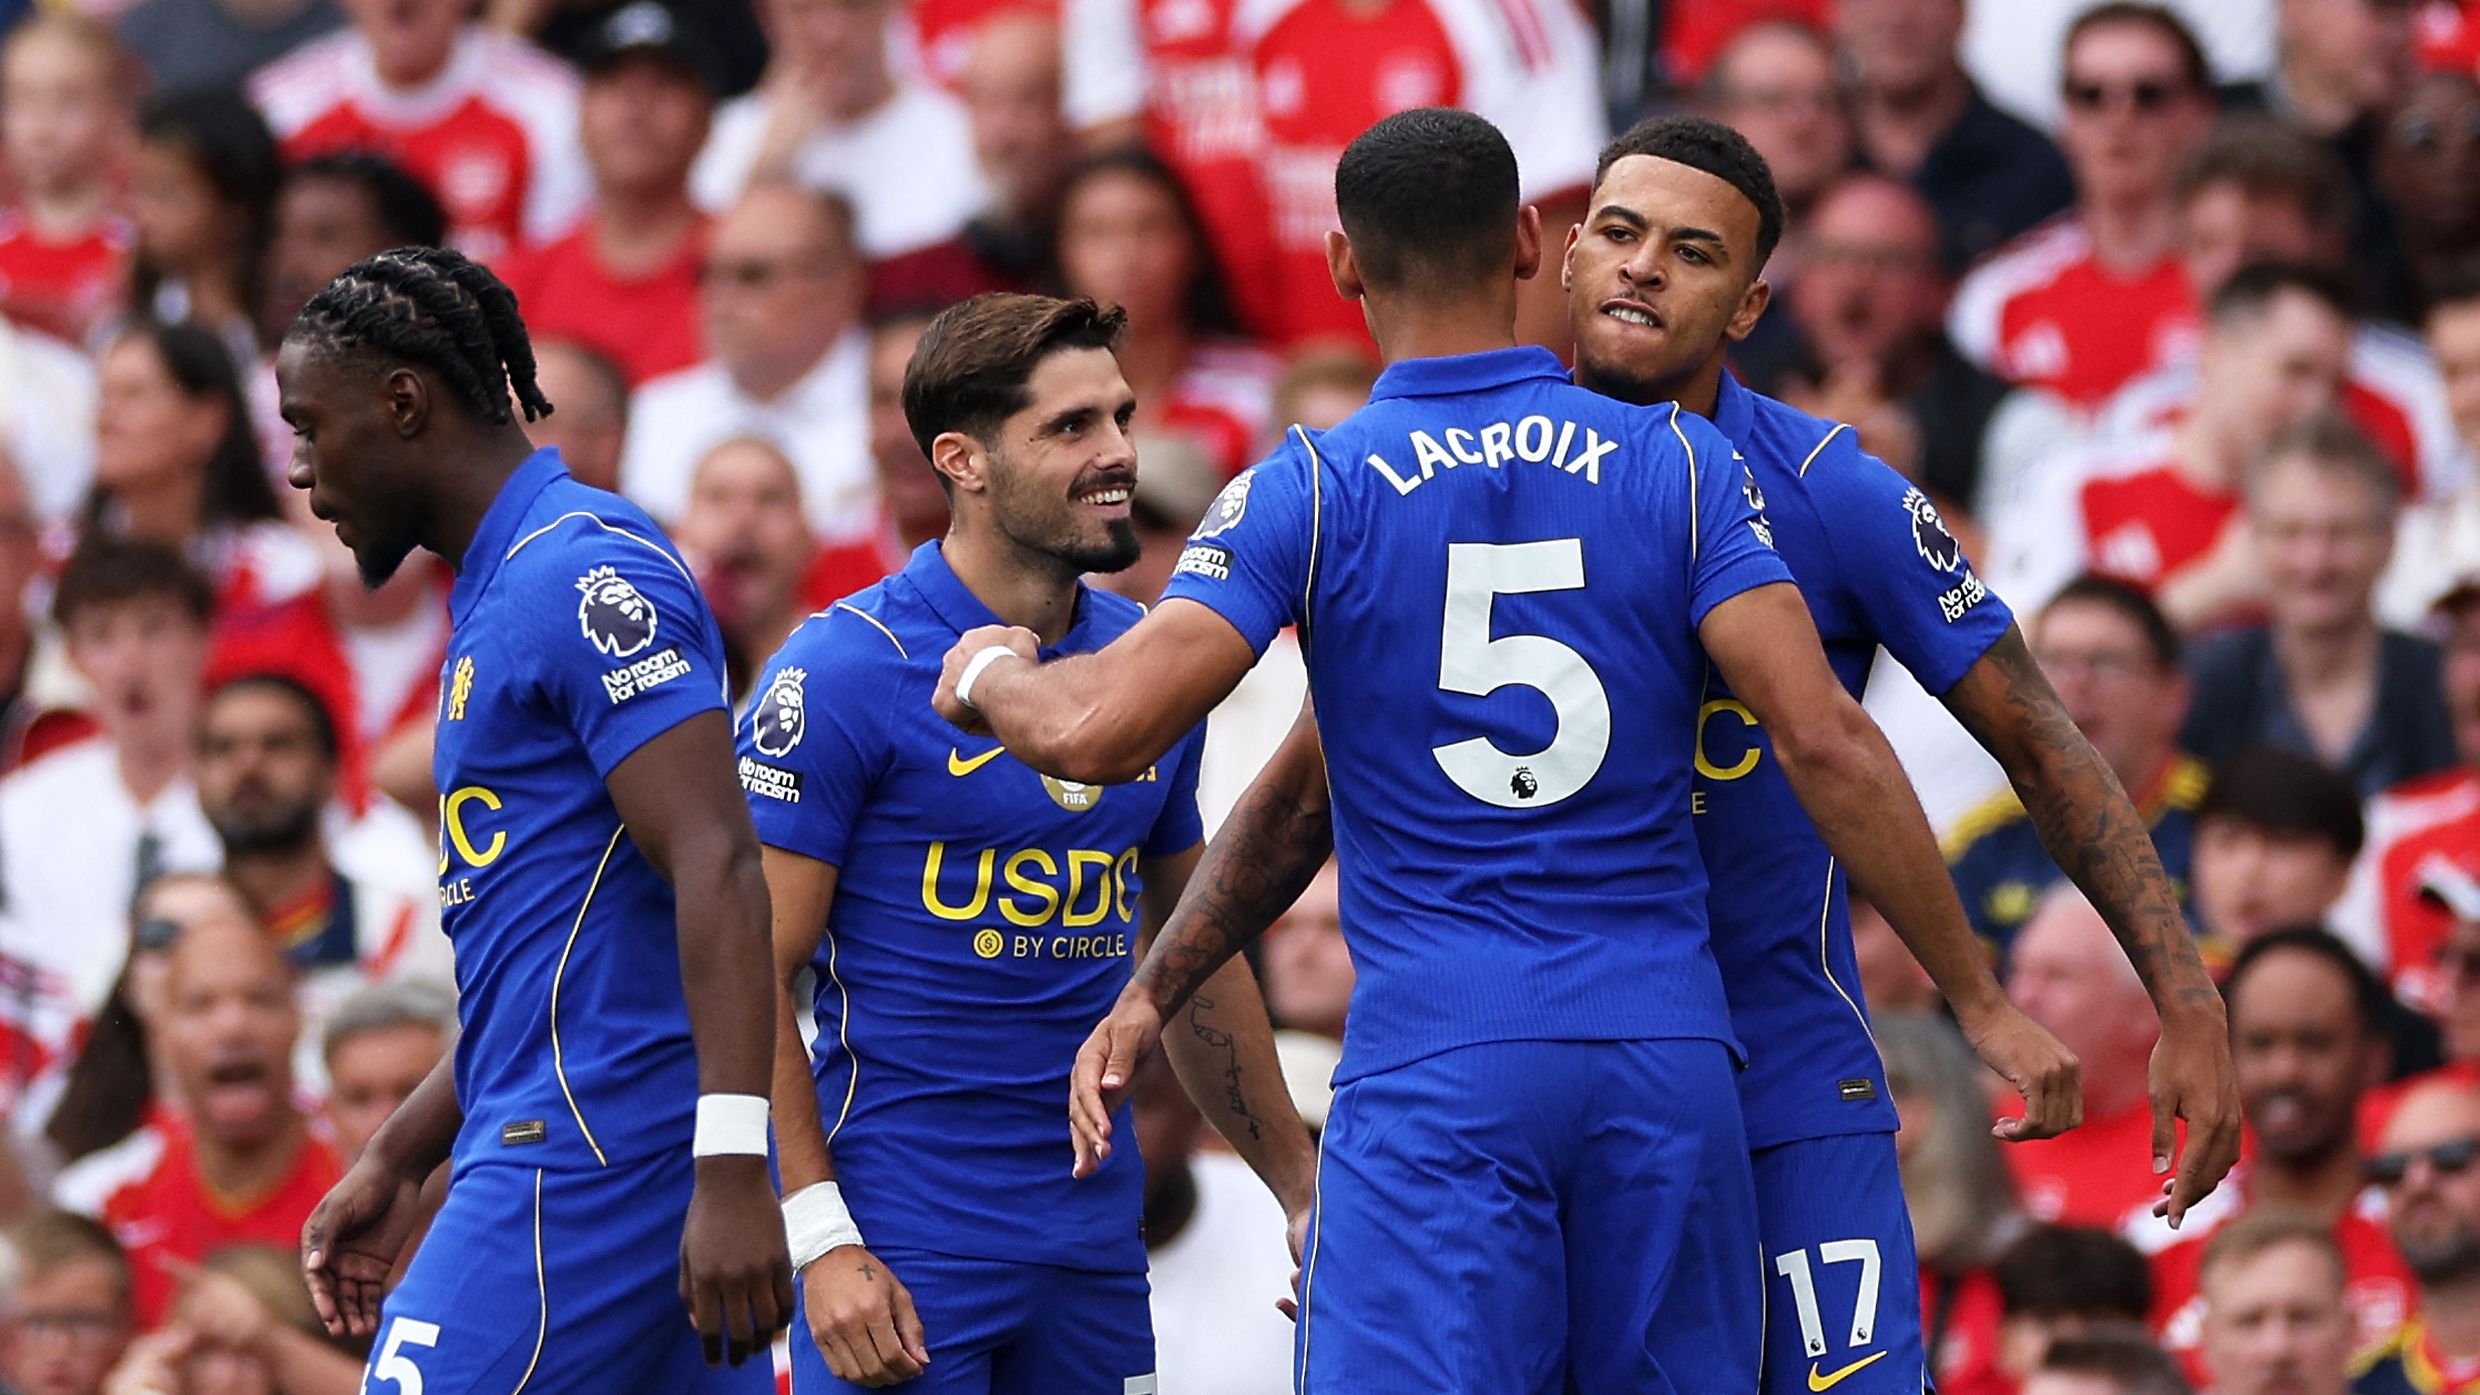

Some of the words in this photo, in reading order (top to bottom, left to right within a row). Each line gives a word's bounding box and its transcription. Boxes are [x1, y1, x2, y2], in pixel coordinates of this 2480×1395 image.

[1367, 415, 1619, 497] LACROIX
[1938, 589, 1962, 611] No
[1944, 600, 1965, 623] for
[601, 669, 632, 692] No
[629, 649, 678, 678] room
[609, 681, 635, 704] for
[635, 660, 692, 691] racism
[1432, 538, 1611, 808] 5
[750, 778, 801, 803] racism
[754, 764, 795, 788] room
[1063, 793, 1088, 805] FIFA
[922, 841, 1140, 927] USDC
[1013, 936, 1044, 958] BY
[1052, 934, 1128, 960] CIRCLE
[1775, 1239, 1882, 1358] 17
[360, 1316, 441, 1395] 5
